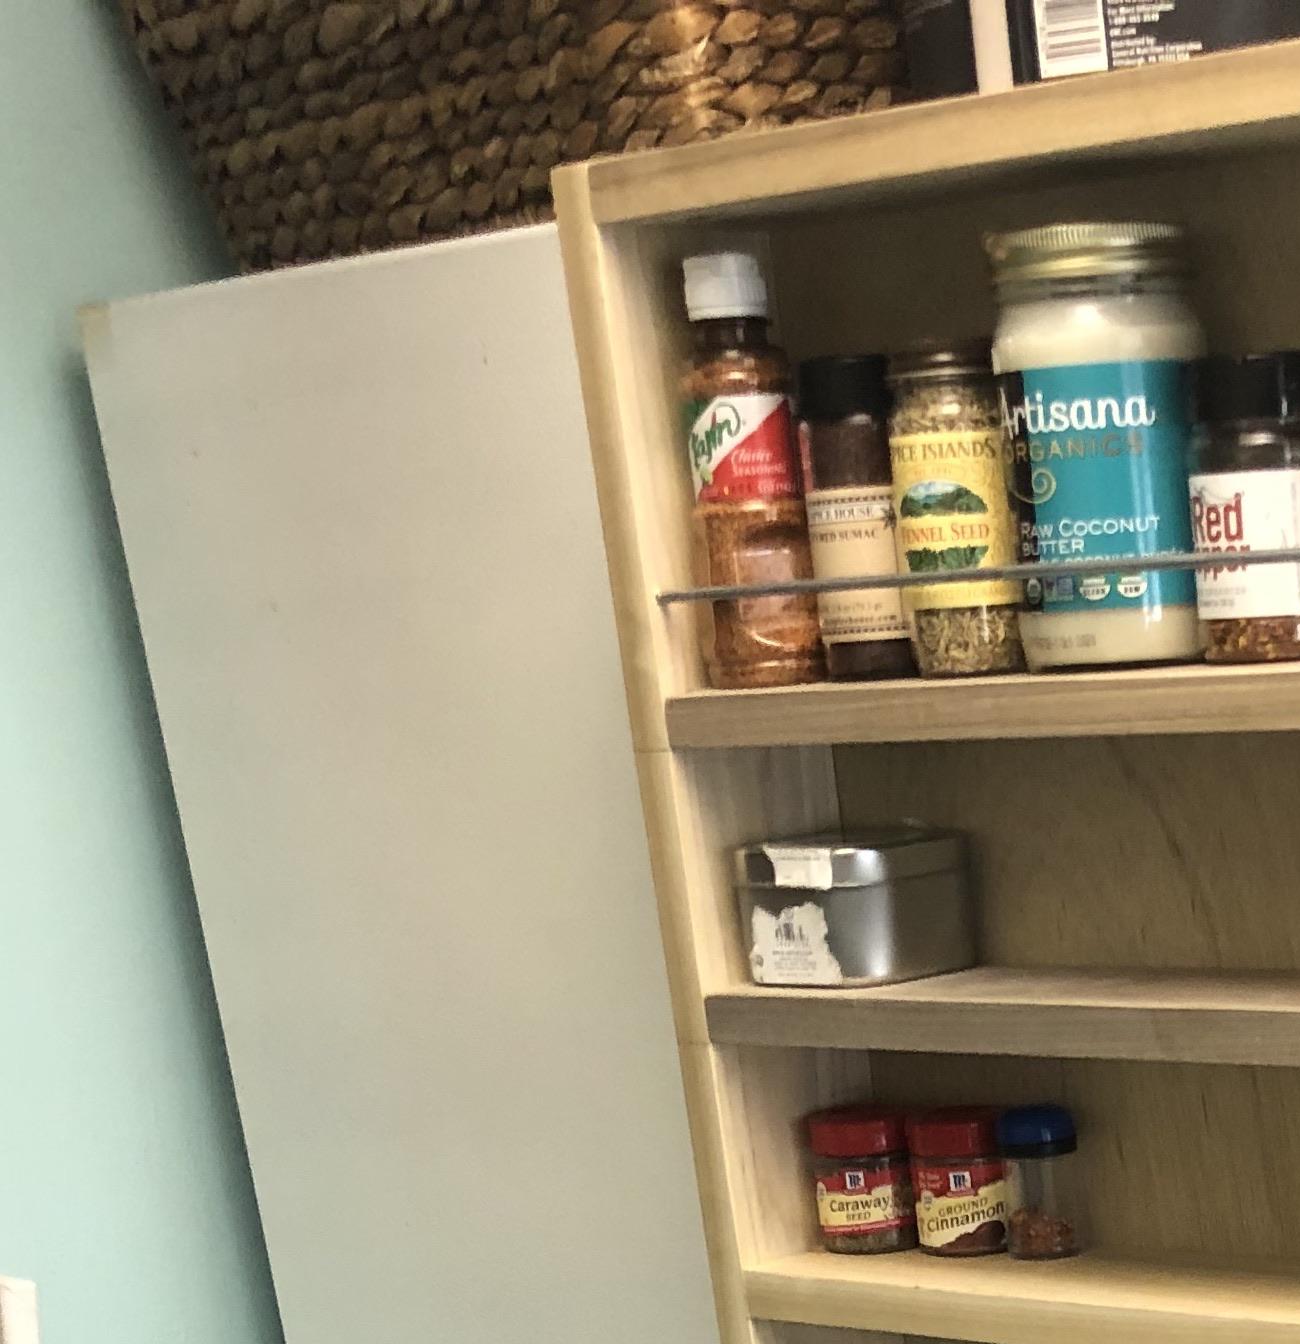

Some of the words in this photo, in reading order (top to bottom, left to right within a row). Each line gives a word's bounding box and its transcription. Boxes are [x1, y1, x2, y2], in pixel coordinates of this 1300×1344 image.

[999, 387, 1157, 440] Artisana
[922, 438, 997, 461] ISLANDS
[1021, 522, 1054, 540] RAW
[1058, 515, 1160, 538] COCONUT
[1192, 493, 1244, 544] Red
[951, 523, 990, 542] SEED
[1022, 538, 1085, 557] BUTTER
[829, 1195, 890, 1213] Caraway
[938, 1197, 990, 1218] GROUND
[926, 1202, 1005, 1233] Cinnamon
